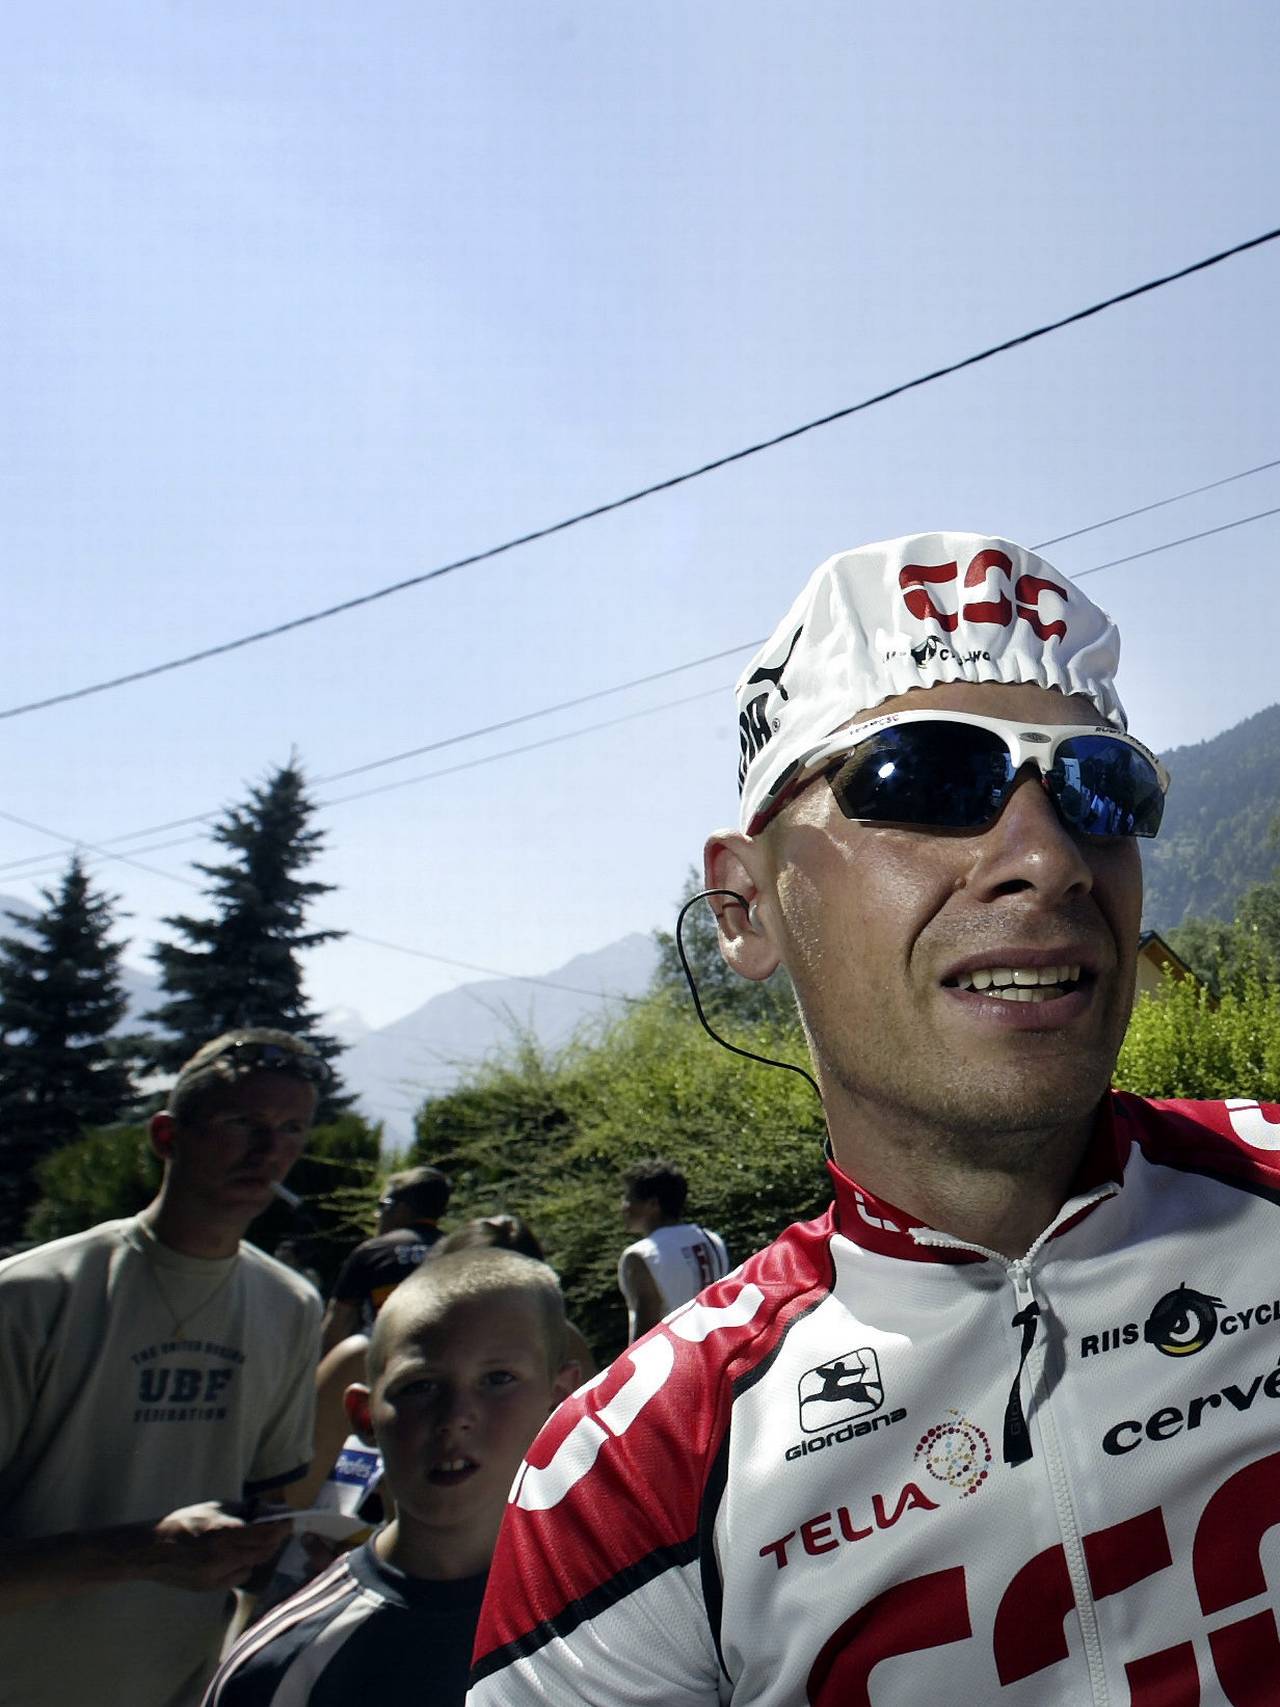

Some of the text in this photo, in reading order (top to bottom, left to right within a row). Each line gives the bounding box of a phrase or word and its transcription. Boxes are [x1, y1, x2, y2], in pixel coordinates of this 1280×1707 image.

[899, 549, 1068, 642] CSC
[1081, 1323, 1140, 1358] RIIS
[760, 1482, 941, 1570] TELIA
